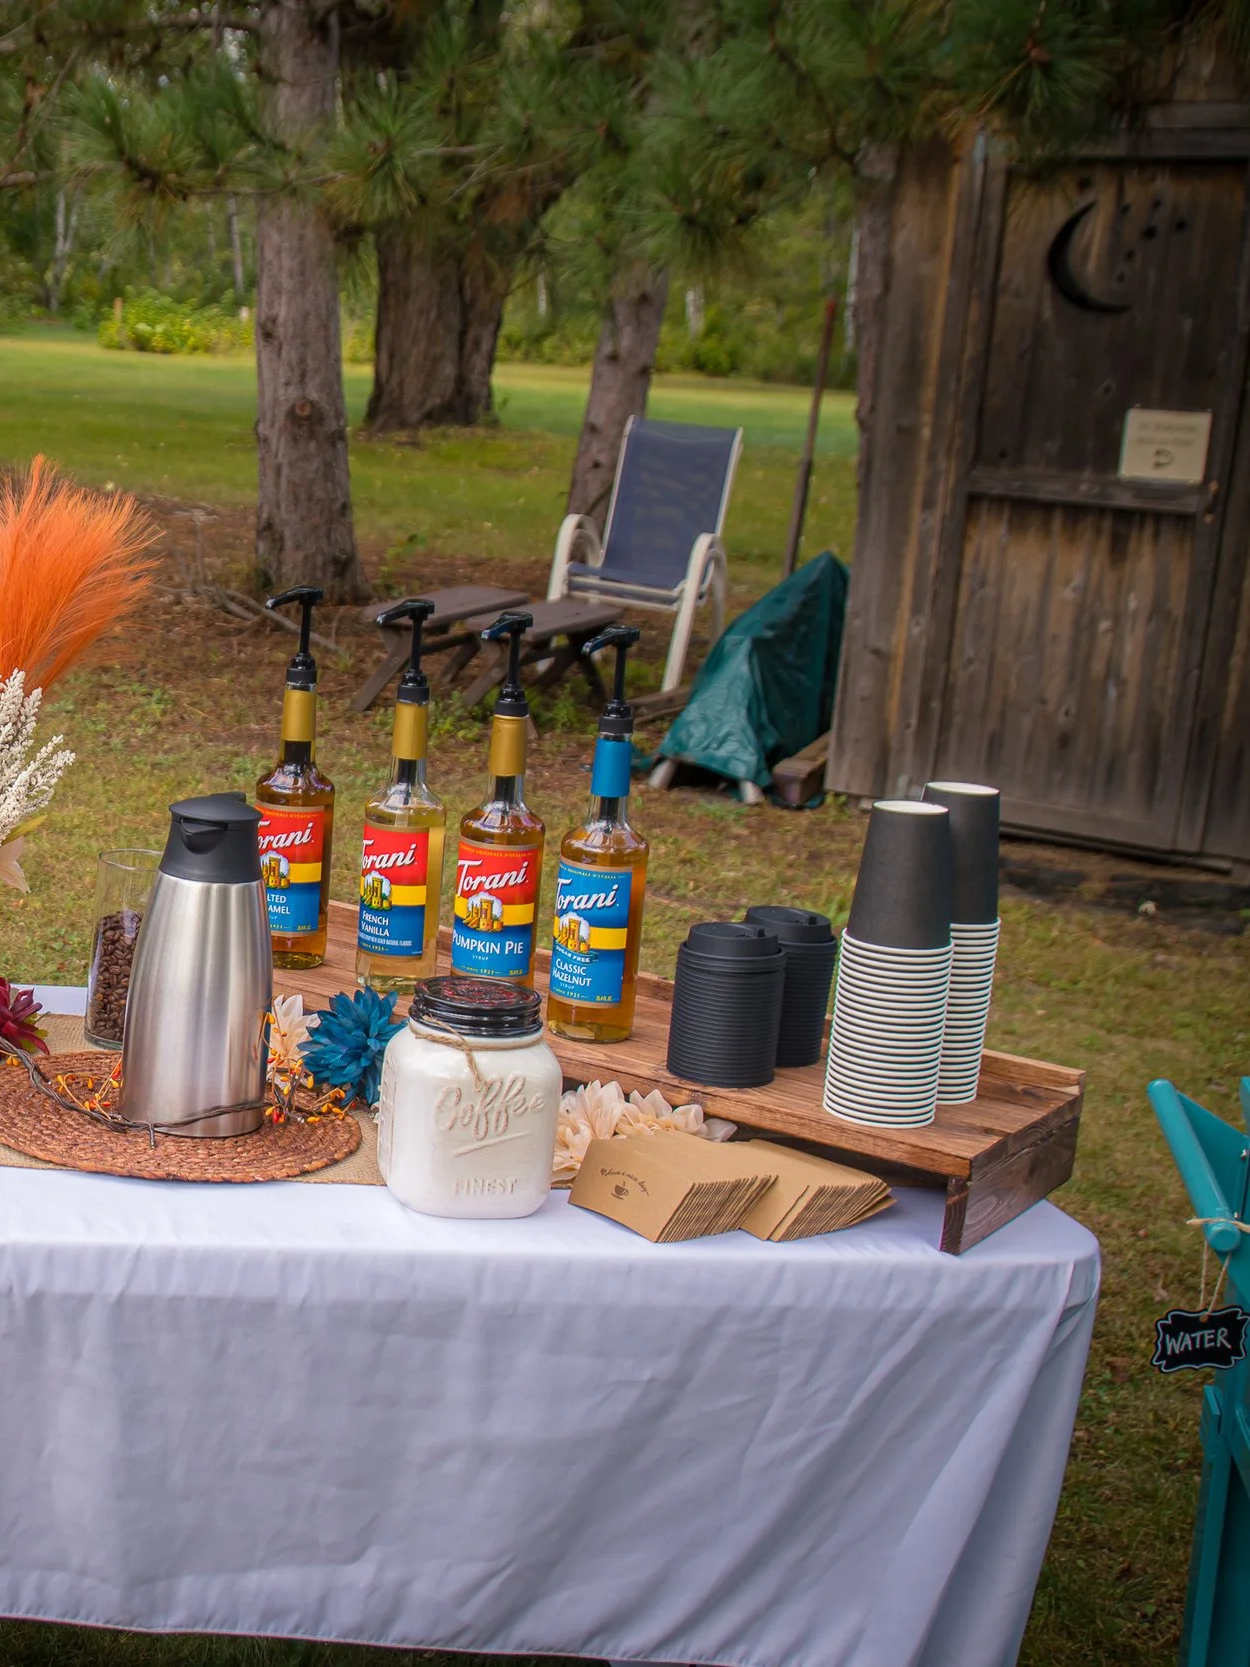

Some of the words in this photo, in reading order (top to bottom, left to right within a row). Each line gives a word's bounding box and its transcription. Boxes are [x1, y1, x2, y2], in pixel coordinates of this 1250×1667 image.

[457, 860, 529, 897] Torani
[267, 893, 287, 904] LTED
[555, 878, 619, 912] Torani
[268, 905, 290, 915] AMEL
[362, 910, 389, 926] FRENCH
[361, 921, 390, 937] VANILLA
[452, 929, 501, 955] PUMPKIN
[505, 940, 524, 955] PIE
[556, 945, 572, 958] SUGAR
[572, 955, 591, 963] FREE
[552, 967, 592, 987] HAZELNUT
[556, 958, 587, 976] CLASSIC
[432, 1074, 548, 1141] Coffee
[453, 1176, 519, 1196] FINEST
[1165, 1327, 1232, 1356] WATER
